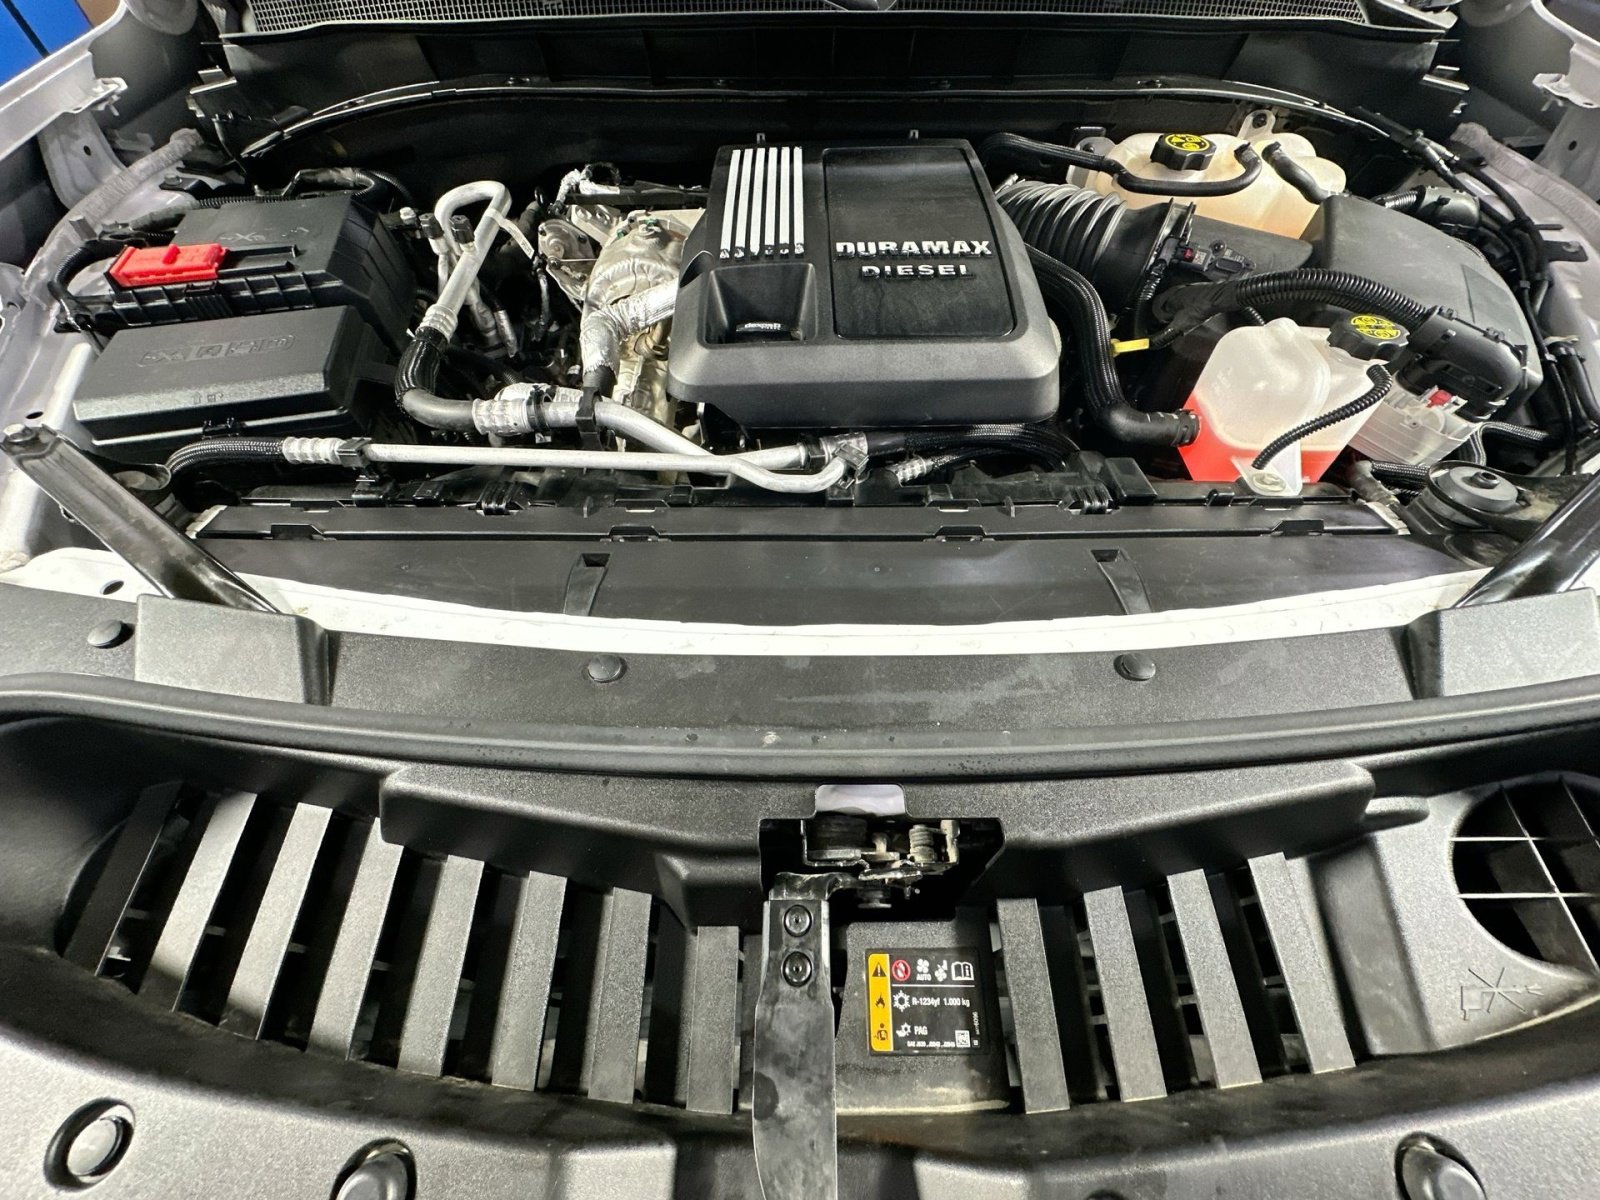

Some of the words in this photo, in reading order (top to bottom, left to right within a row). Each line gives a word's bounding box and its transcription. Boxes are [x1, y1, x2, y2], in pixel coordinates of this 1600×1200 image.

[835, 240, 993, 258] DURAMAX
[861, 264, 974, 279] DIESEL
[916, 974, 932, 982] AUTO
[912, 997, 940, 1007] R-1234yf
[943, 997, 961, 1006] 1.000
[962, 998, 971, 1008] kg
[914, 1026, 928, 1035] PAG
